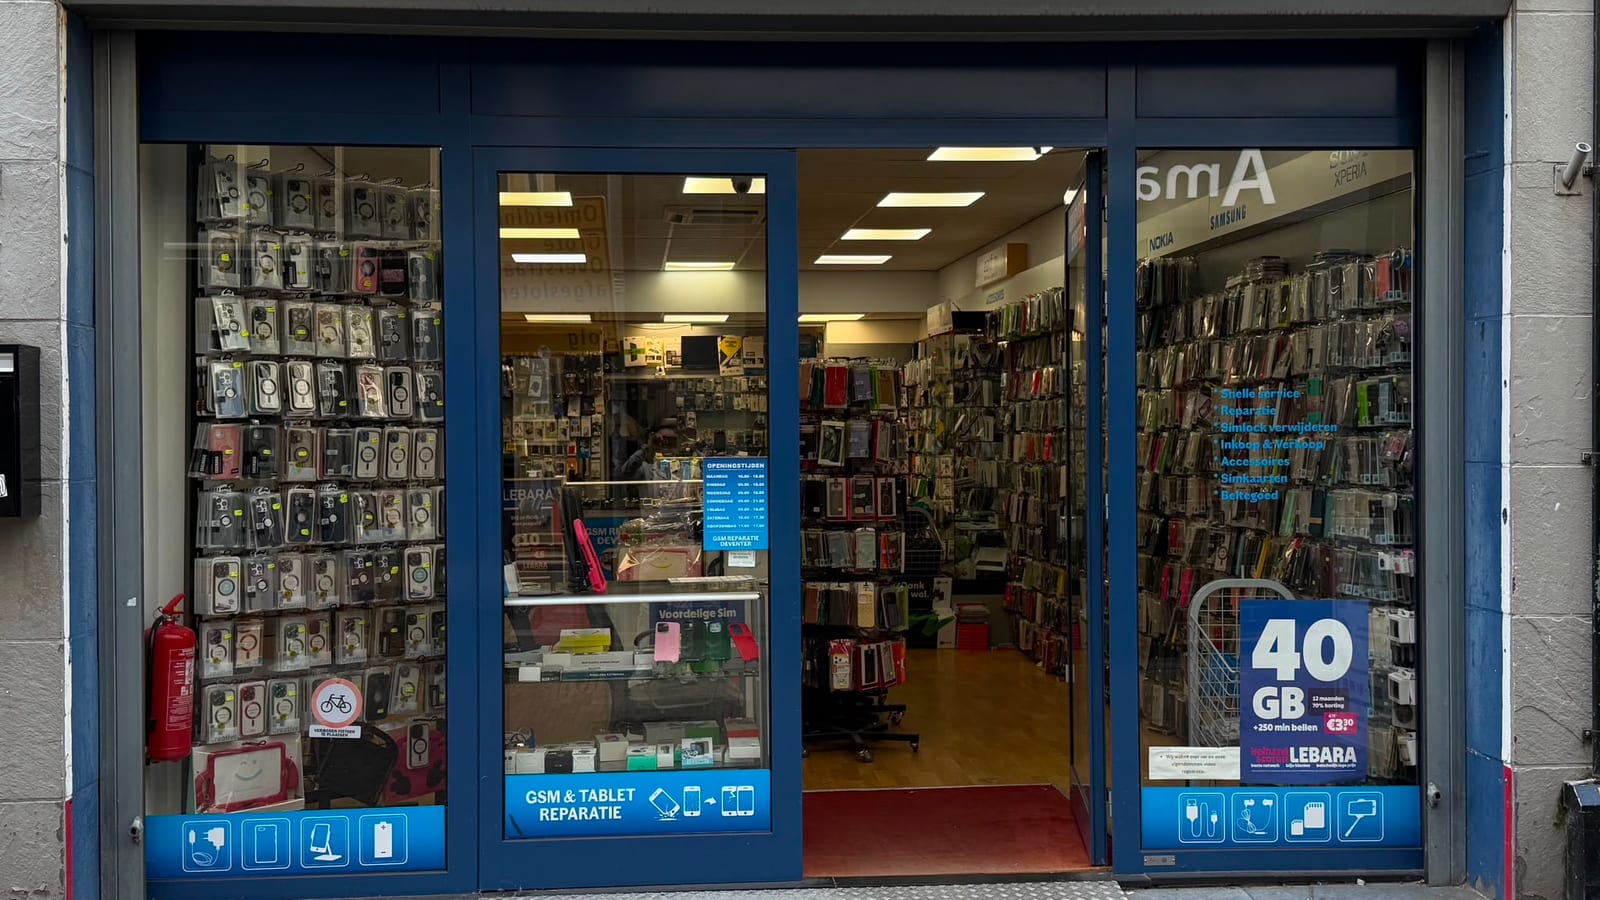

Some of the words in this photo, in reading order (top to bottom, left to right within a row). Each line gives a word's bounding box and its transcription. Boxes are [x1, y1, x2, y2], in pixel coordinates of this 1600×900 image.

[1334, 160, 1368, 188] XPERIA
[1210, 205, 1247, 231] SAMSUNG
[1149, 231, 1174, 252] NOKIA
[1220, 388, 1256, 399] Snelle
[1257, 389, 1301, 399] service
[1220, 405, 1278, 418] Reparatie
[1220, 422, 1267, 433] Simlock
[1268, 422, 1338, 435] verwijderen
[1220, 439, 1260, 451] Inkoop
[1262, 439, 1273, 450] &
[1274, 439, 1324, 451] Verkoop
[1220, 456, 1291, 467] Accessoires
[1220, 473, 1288, 484] Simkaarten
[503, 488, 554, 501] LEBARA
[1220, 490, 1279, 503] Beltegoed
[597, 537, 618, 545] DEV
[659, 608, 716, 620] Voordelige
[717, 608, 737, 618] Sim
[1252, 618, 1354, 683] 40
[1252, 686, 1305, 720] GB
[1253, 724, 1274, 732] +250
[1274, 723, 1291, 732] min
[1291, 723, 1318, 732] bellen
[1289, 746, 1357, 763] LEBARA
[525, 790, 561, 805] GSM
[563, 790, 577, 804] &
[578, 788, 636, 803] TABLET
[539, 805, 622, 822] REPARATIE
